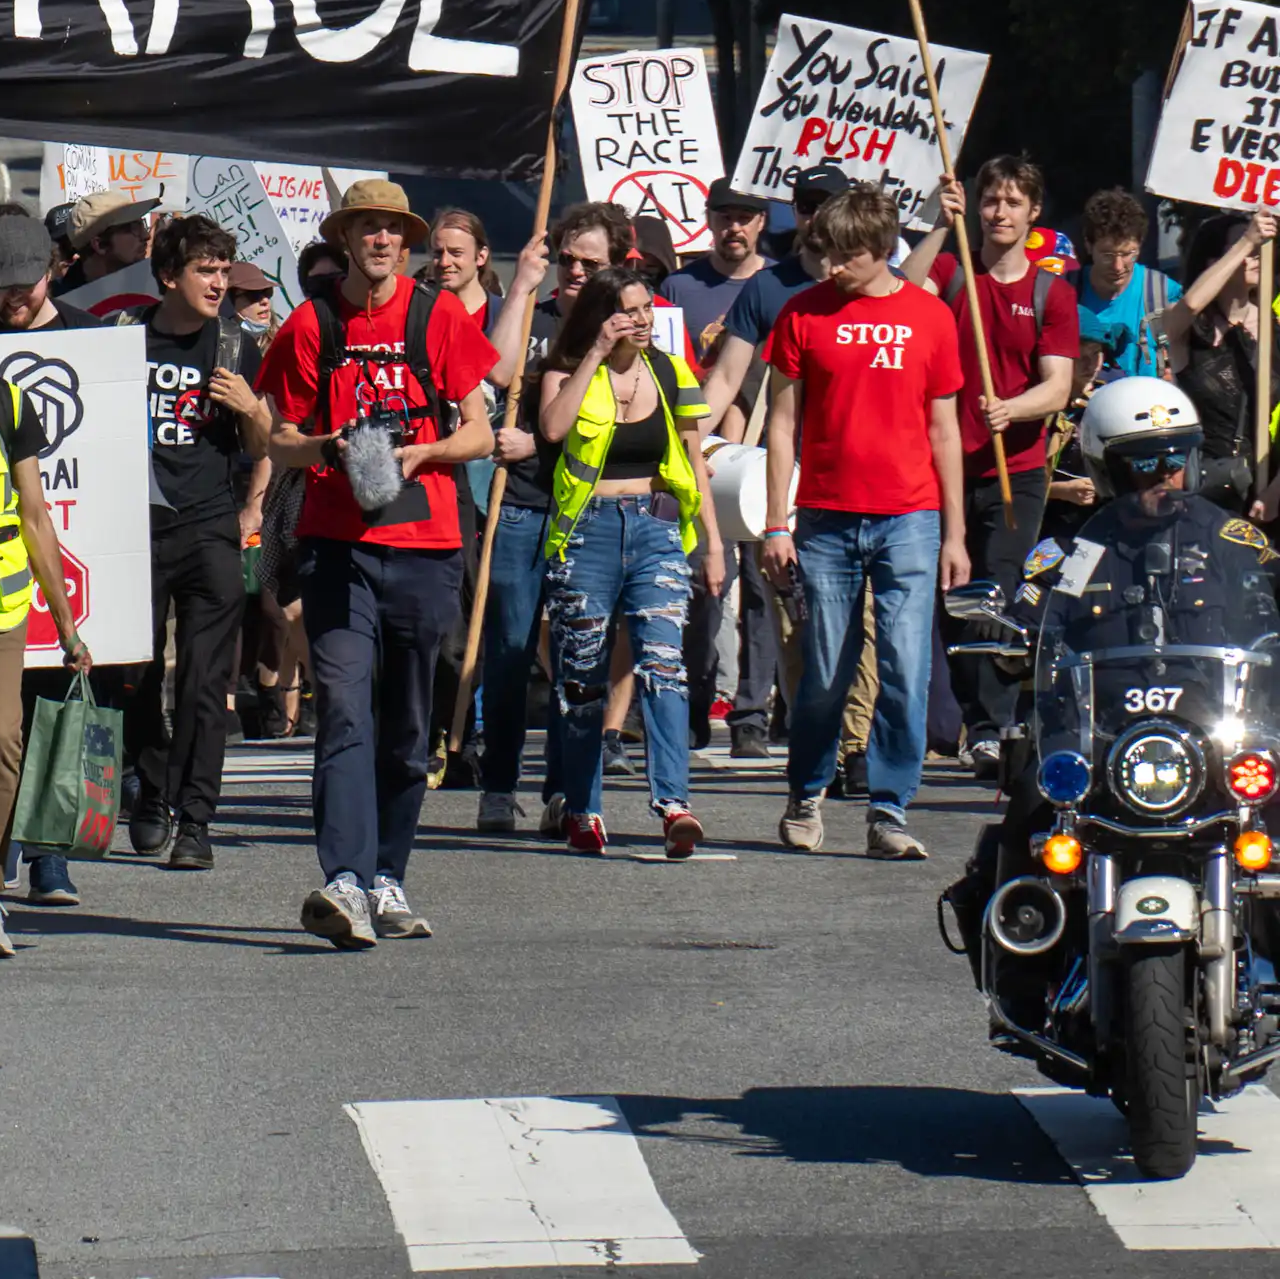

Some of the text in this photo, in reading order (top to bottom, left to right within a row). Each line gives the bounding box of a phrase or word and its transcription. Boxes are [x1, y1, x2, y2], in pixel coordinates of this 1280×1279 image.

[1191, 6, 1243, 49] IF
[782, 23, 947, 101] You Said
[581, 56, 696, 107] STOP
[759, 77, 819, 122] You
[606, 108, 684, 137] THE
[594, 137, 700, 172] RACE
[793, 116, 898, 166] PUSH
[108, 151, 178, 182] USE
[193, 155, 245, 199] Can
[752, 145, 802, 189] The
[636, 181, 695, 224] AI
[835, 322, 913, 346] STOP
[145, 361, 201, 391] TOP
[869, 347, 905, 370] AI
[371, 366, 405, 390] AI
[157, 421, 195, 446] CE
[1124, 686, 1184, 714] 367
